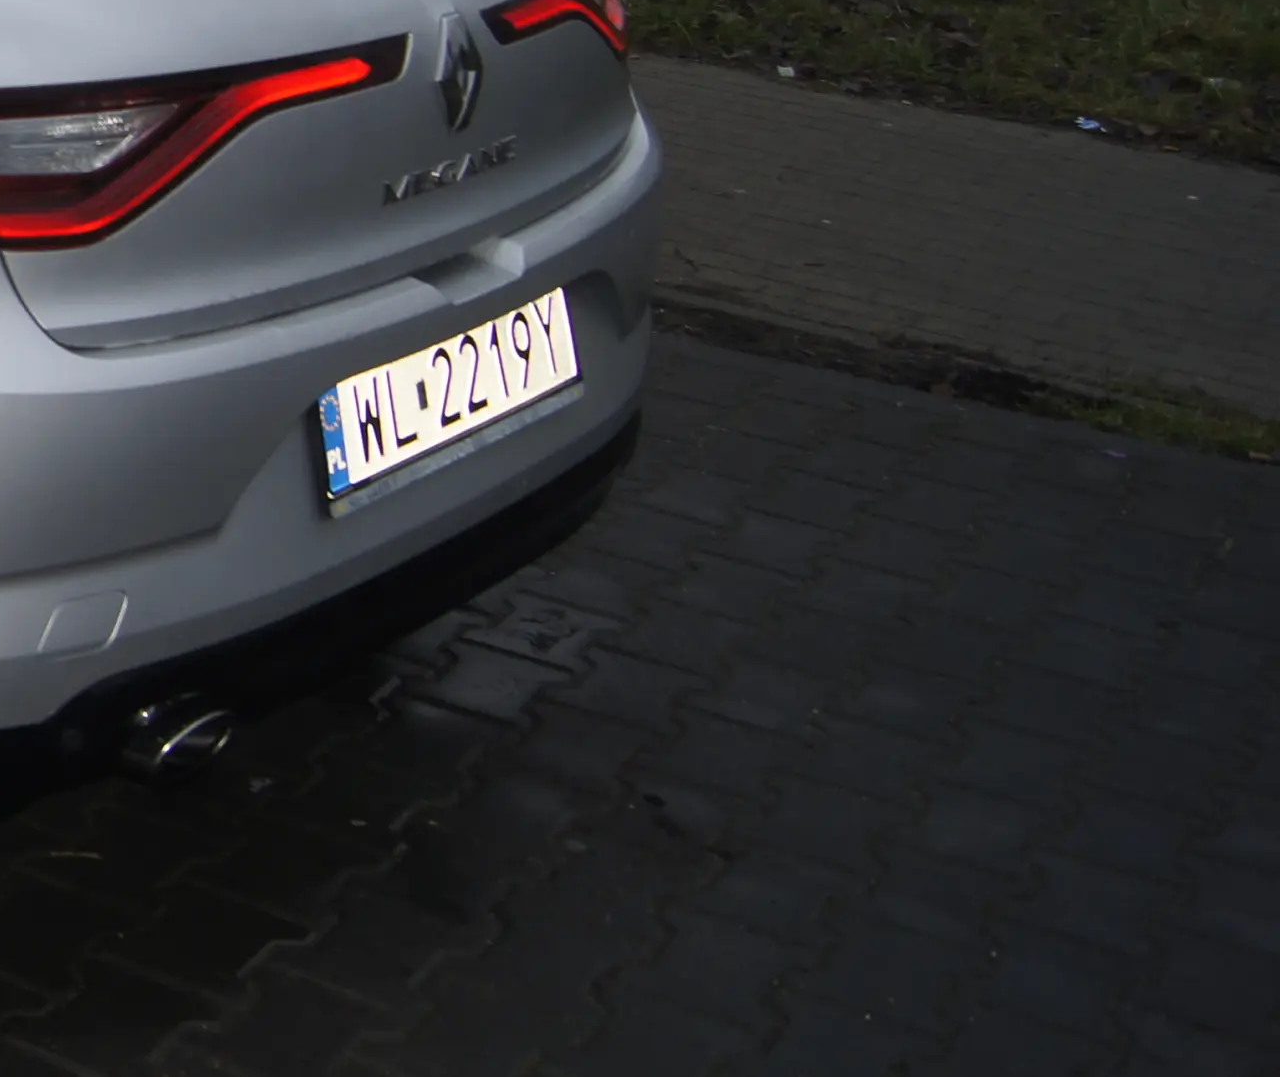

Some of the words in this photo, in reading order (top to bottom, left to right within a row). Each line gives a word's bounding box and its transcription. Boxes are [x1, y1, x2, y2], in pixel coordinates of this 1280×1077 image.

[352, 369, 418, 464] WL
[431, 296, 558, 428] 2219Y
[326, 446, 347, 475] PL
